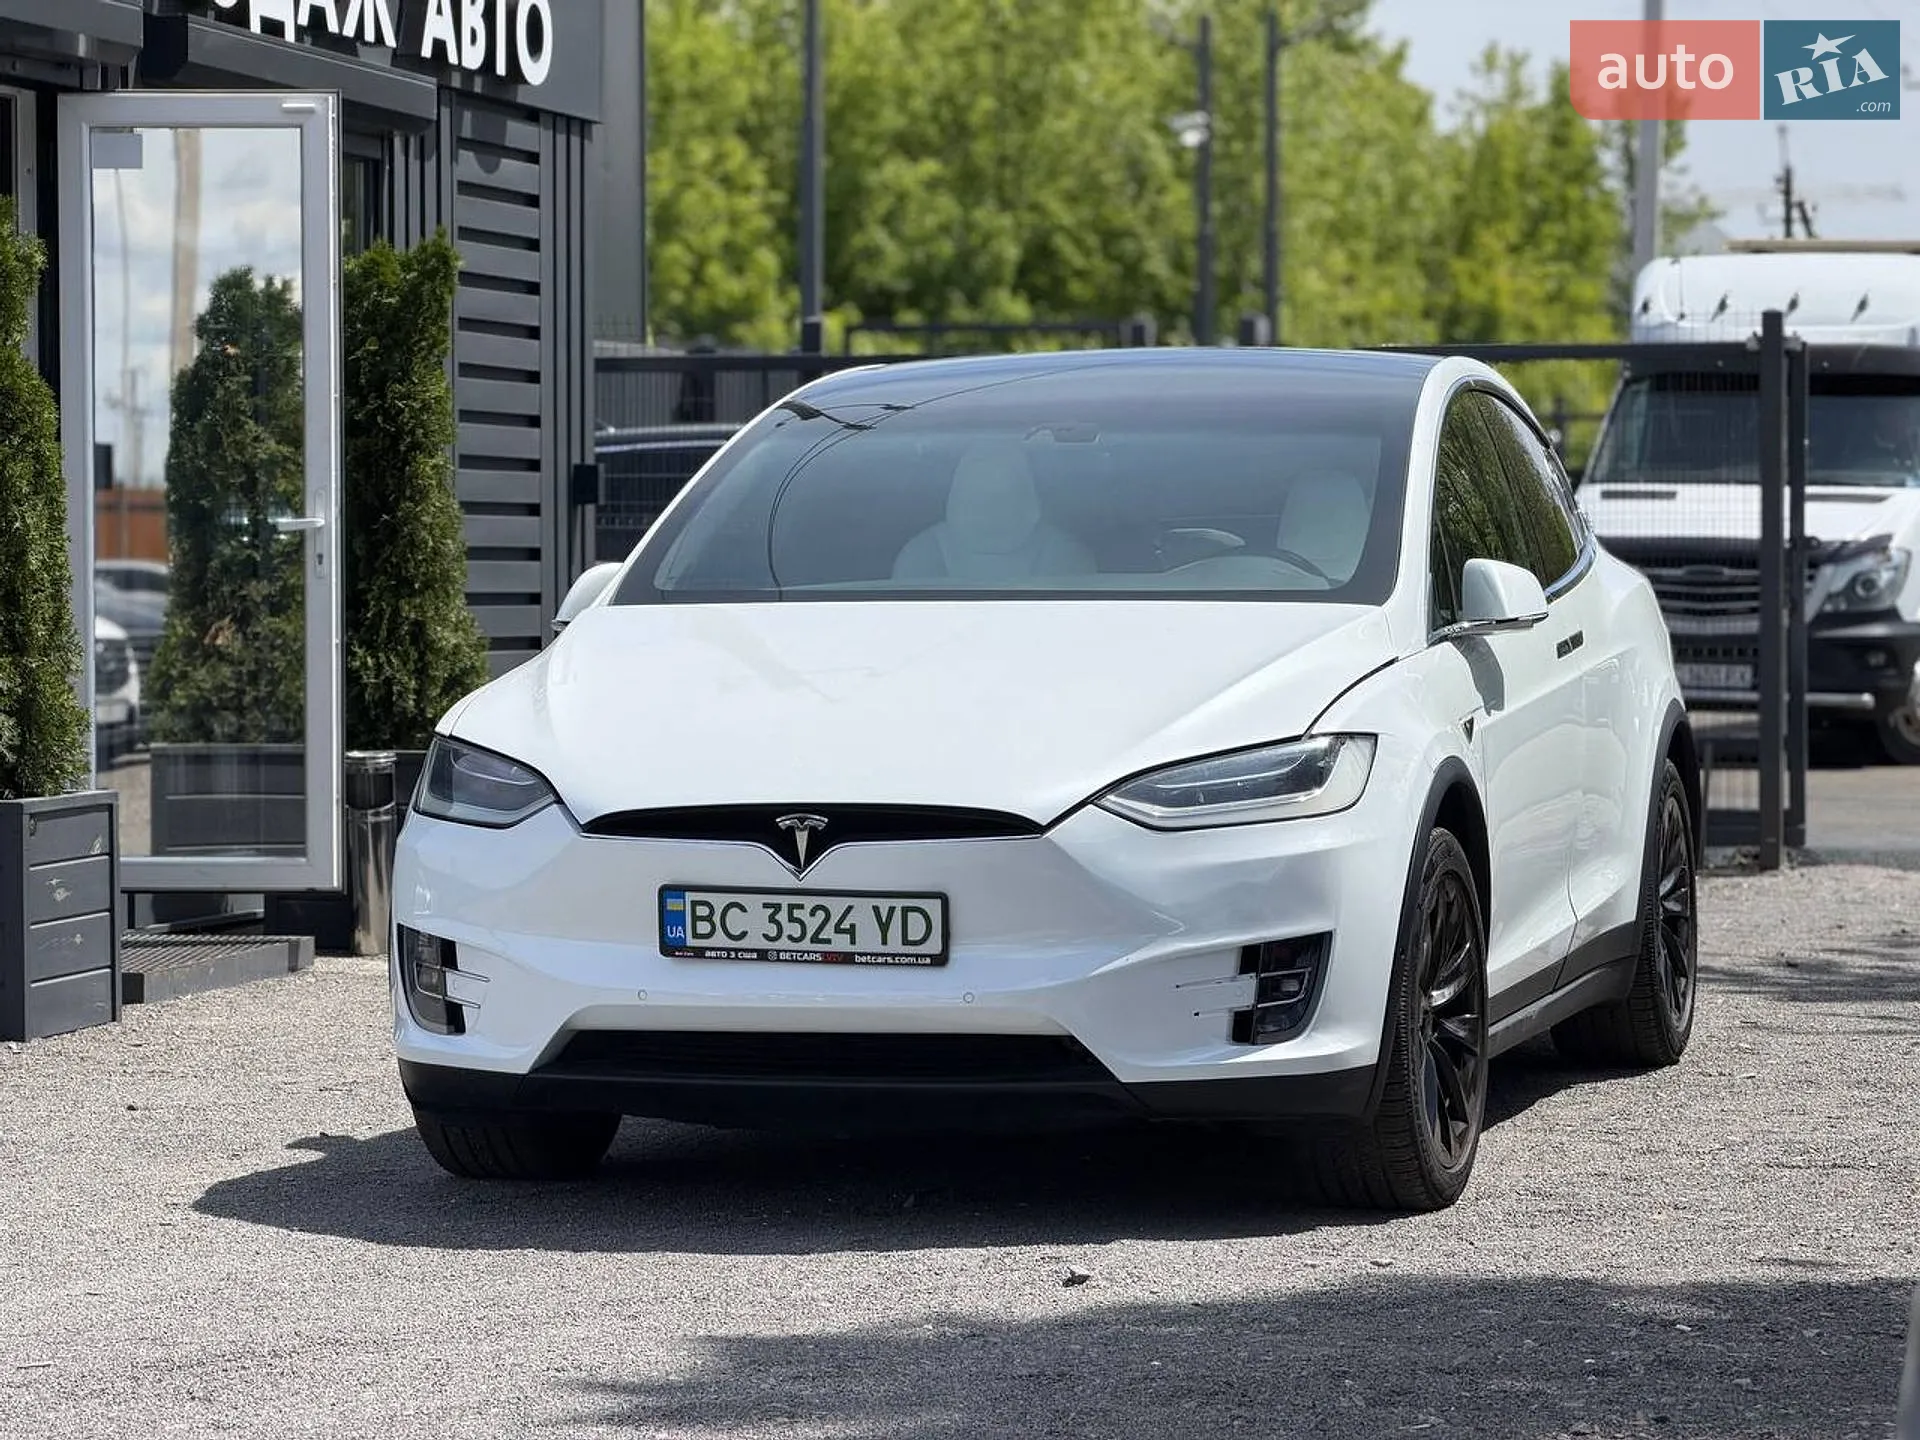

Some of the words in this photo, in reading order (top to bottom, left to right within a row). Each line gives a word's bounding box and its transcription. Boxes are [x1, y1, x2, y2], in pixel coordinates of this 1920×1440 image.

[690, 900, 748, 942] BC
[762, 903, 857, 945] 3524
[872, 905, 933, 946] YD
[667, 925, 685, 938] UA
[854, 954, 931, 965] betcars.com.ua
